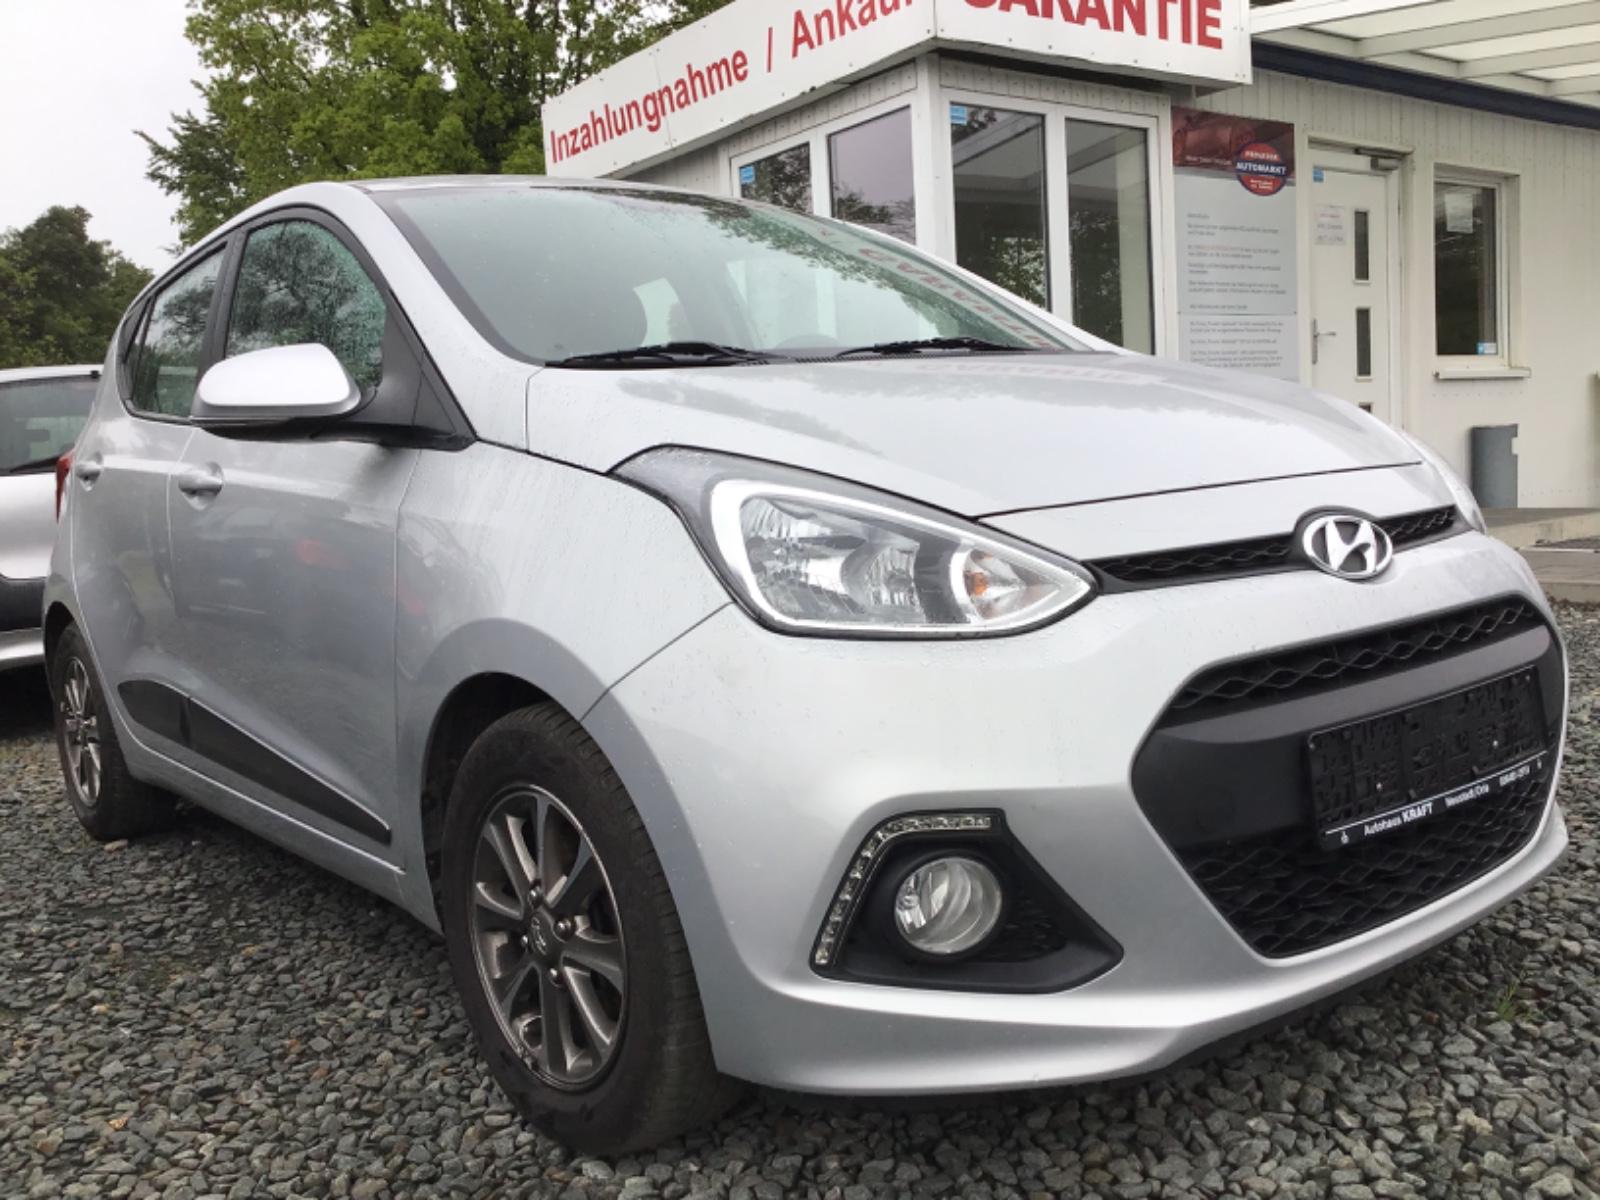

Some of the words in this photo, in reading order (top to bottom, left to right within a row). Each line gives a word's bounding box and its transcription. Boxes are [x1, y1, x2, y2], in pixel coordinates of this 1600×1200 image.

[964, 0, 1223, 50] ANTIE
[550, 50, 748, 164] Inzahlungnahme
[767, 26, 774, 74] /
[792, 0, 913, 58] Anka
[1235, 161, 1287, 176] AUTOMARKT
[1364, 815, 1402, 836] Autohaus
[1402, 802, 1433, 824] KRAFT
